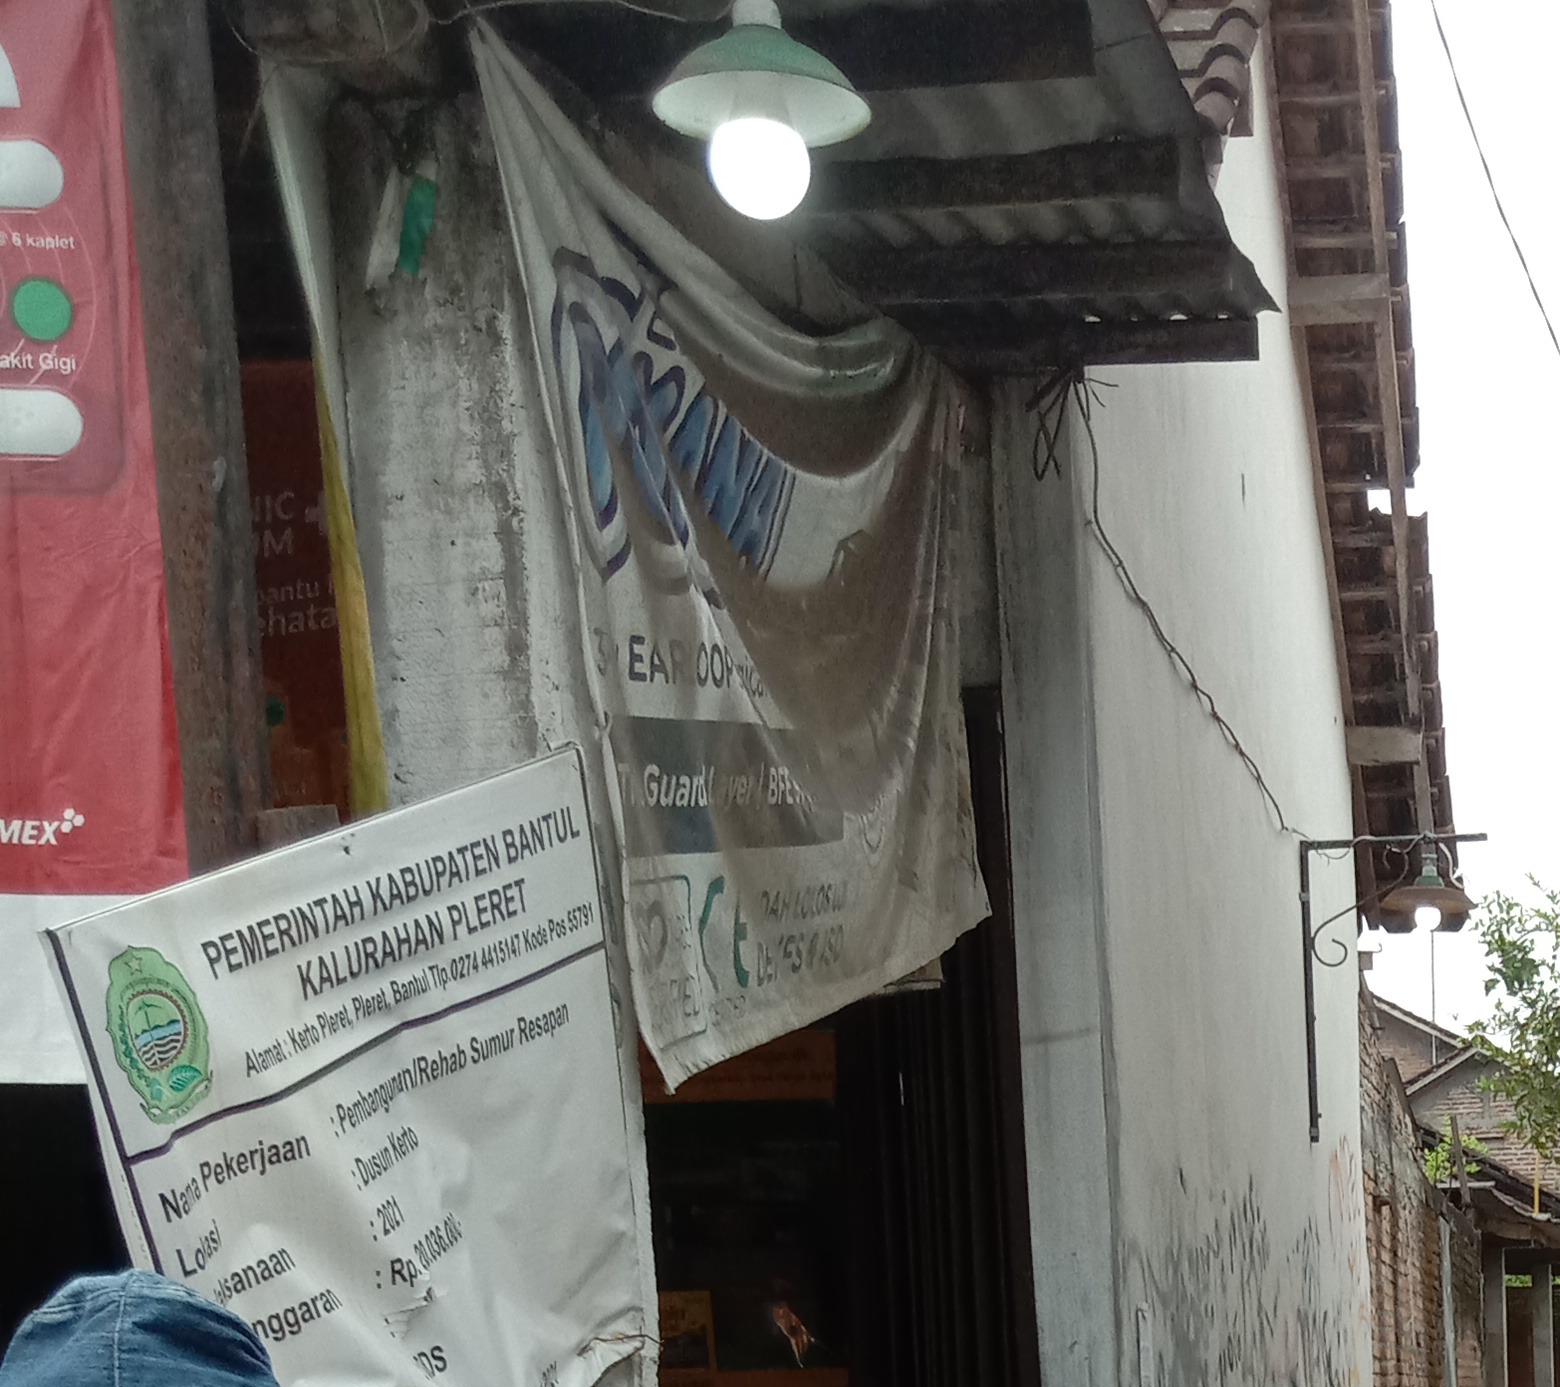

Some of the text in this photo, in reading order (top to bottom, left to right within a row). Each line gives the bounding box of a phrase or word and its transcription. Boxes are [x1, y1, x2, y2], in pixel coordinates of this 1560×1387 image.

[25, 233, 76, 251] kaplet
[0, 352, 77, 376] akit Gigi
[0, 818, 61, 846] MEX
[201, 806, 581, 980] PEMERINTAH KABUPATEN BANTUL
[297, 878, 528, 1001] KALURAHAN PLERET
[245, 1040, 286, 1078] Alamat
[290, 1020, 320, 1055] Kerto
[393, 967, 431, 1006] Bantul
[481, 933, 523, 971] 4415147
[522, 918, 549, 954] Kode
[548, 918, 567, 945] Pos
[566, 901, 595, 933] 55791
[199, 1135, 311, 1193] Pekerjaan
[469, 1026, 516, 1067] Sumur
[516, 1002, 570, 1043] Resapan
[356, 1149, 393, 1188] Dusun
[390, 1124, 420, 1164] Kerto
[376, 1194, 405, 1237] 2021
[251, 1286, 344, 1342] nggaran
